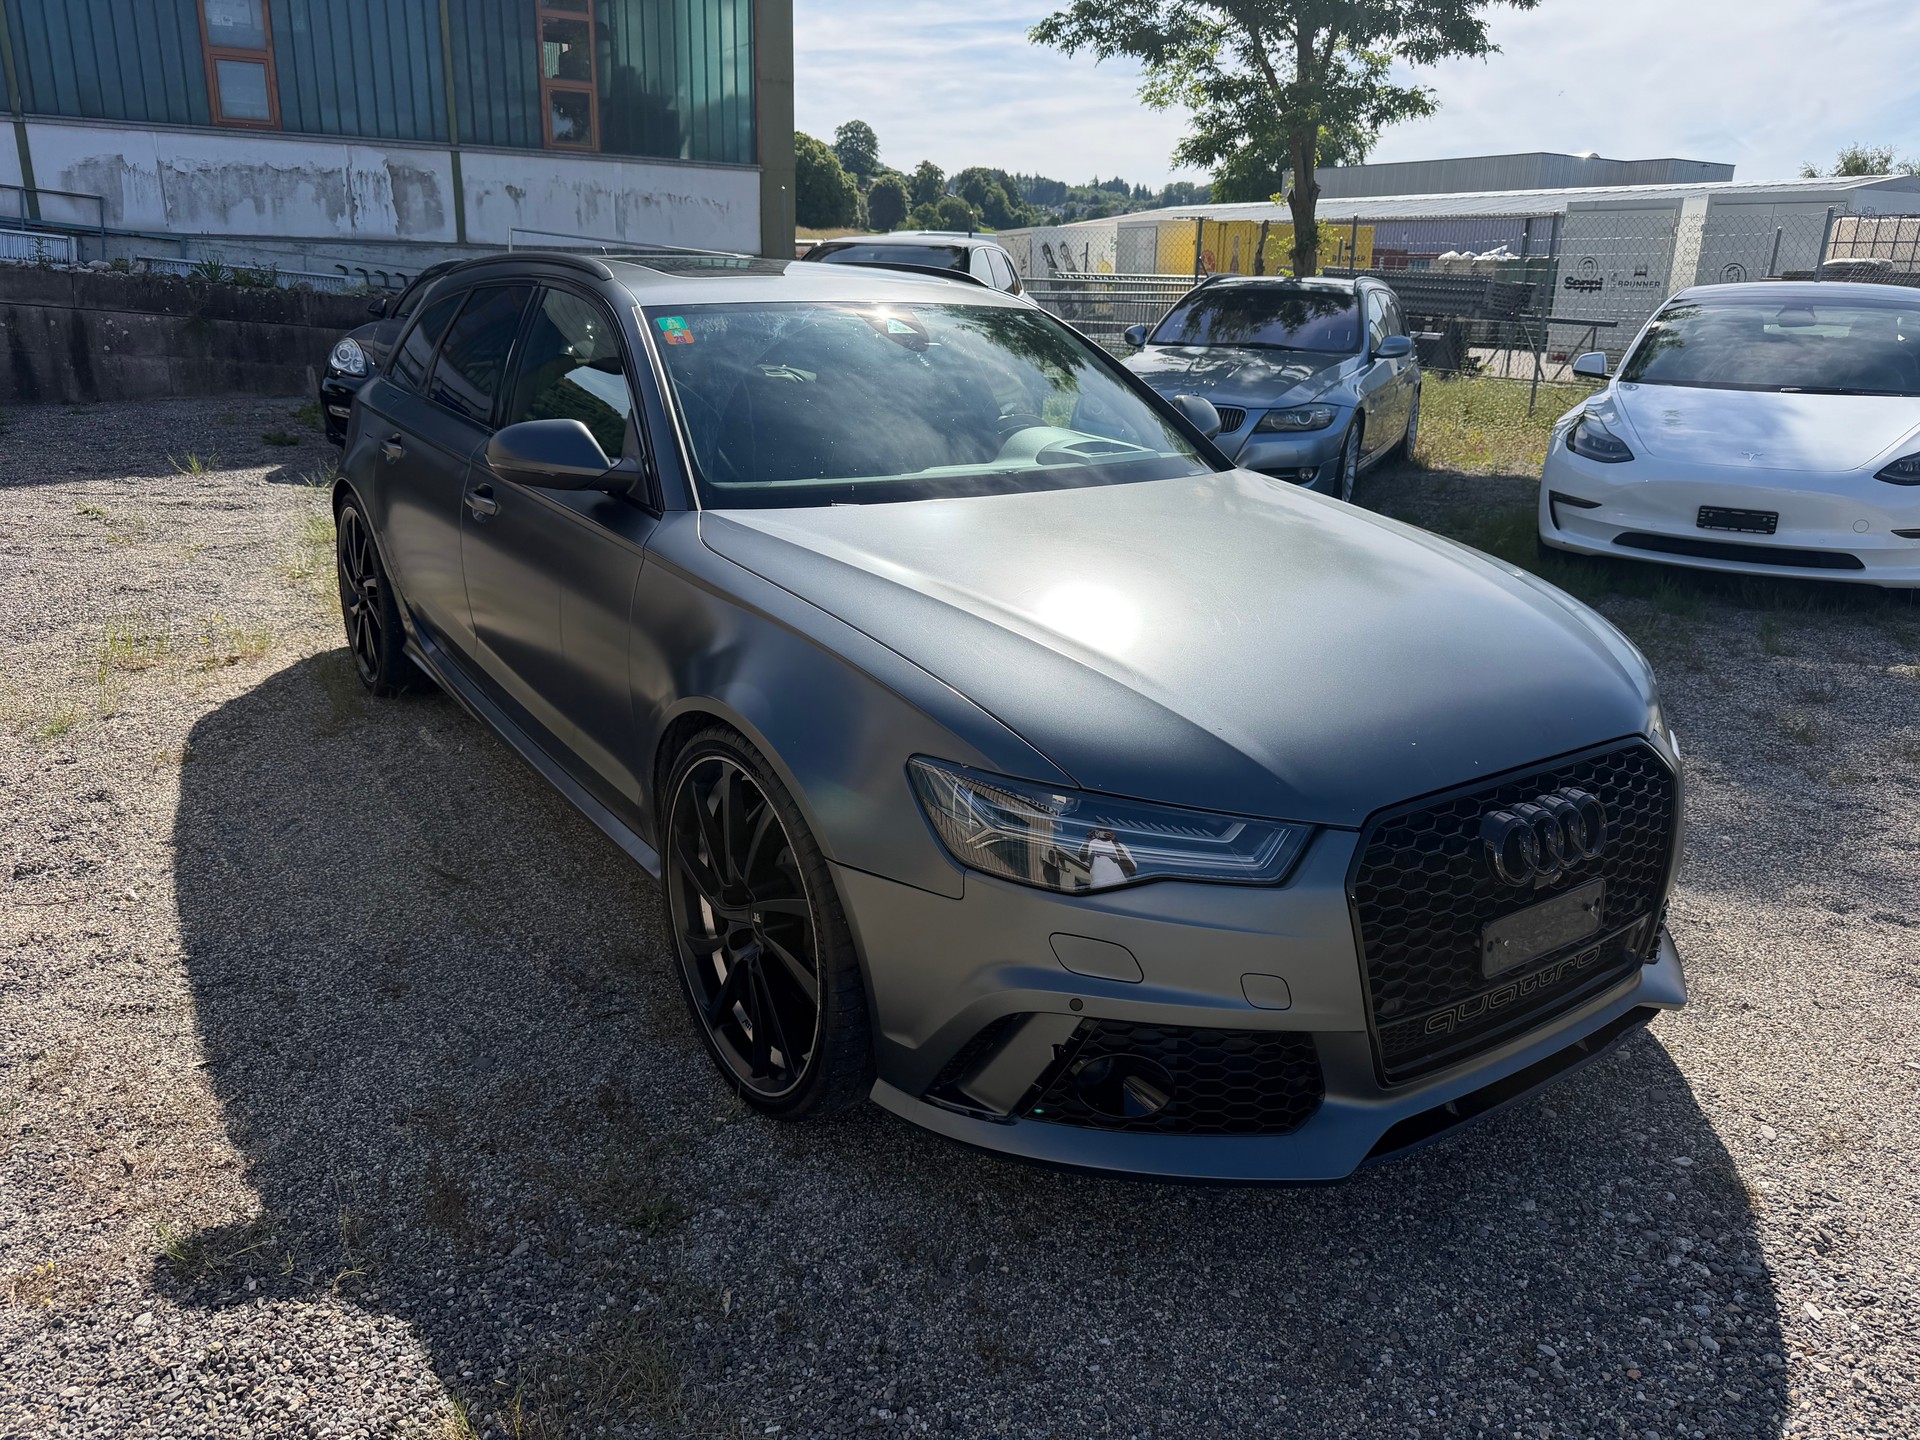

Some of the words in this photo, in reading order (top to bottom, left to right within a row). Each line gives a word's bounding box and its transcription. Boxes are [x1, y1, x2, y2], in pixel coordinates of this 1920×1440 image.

[1332, 254, 1366, 262] BUNER
[1617, 280, 1661, 289] BRUNNER
[1424, 944, 1601, 1034] quattro
